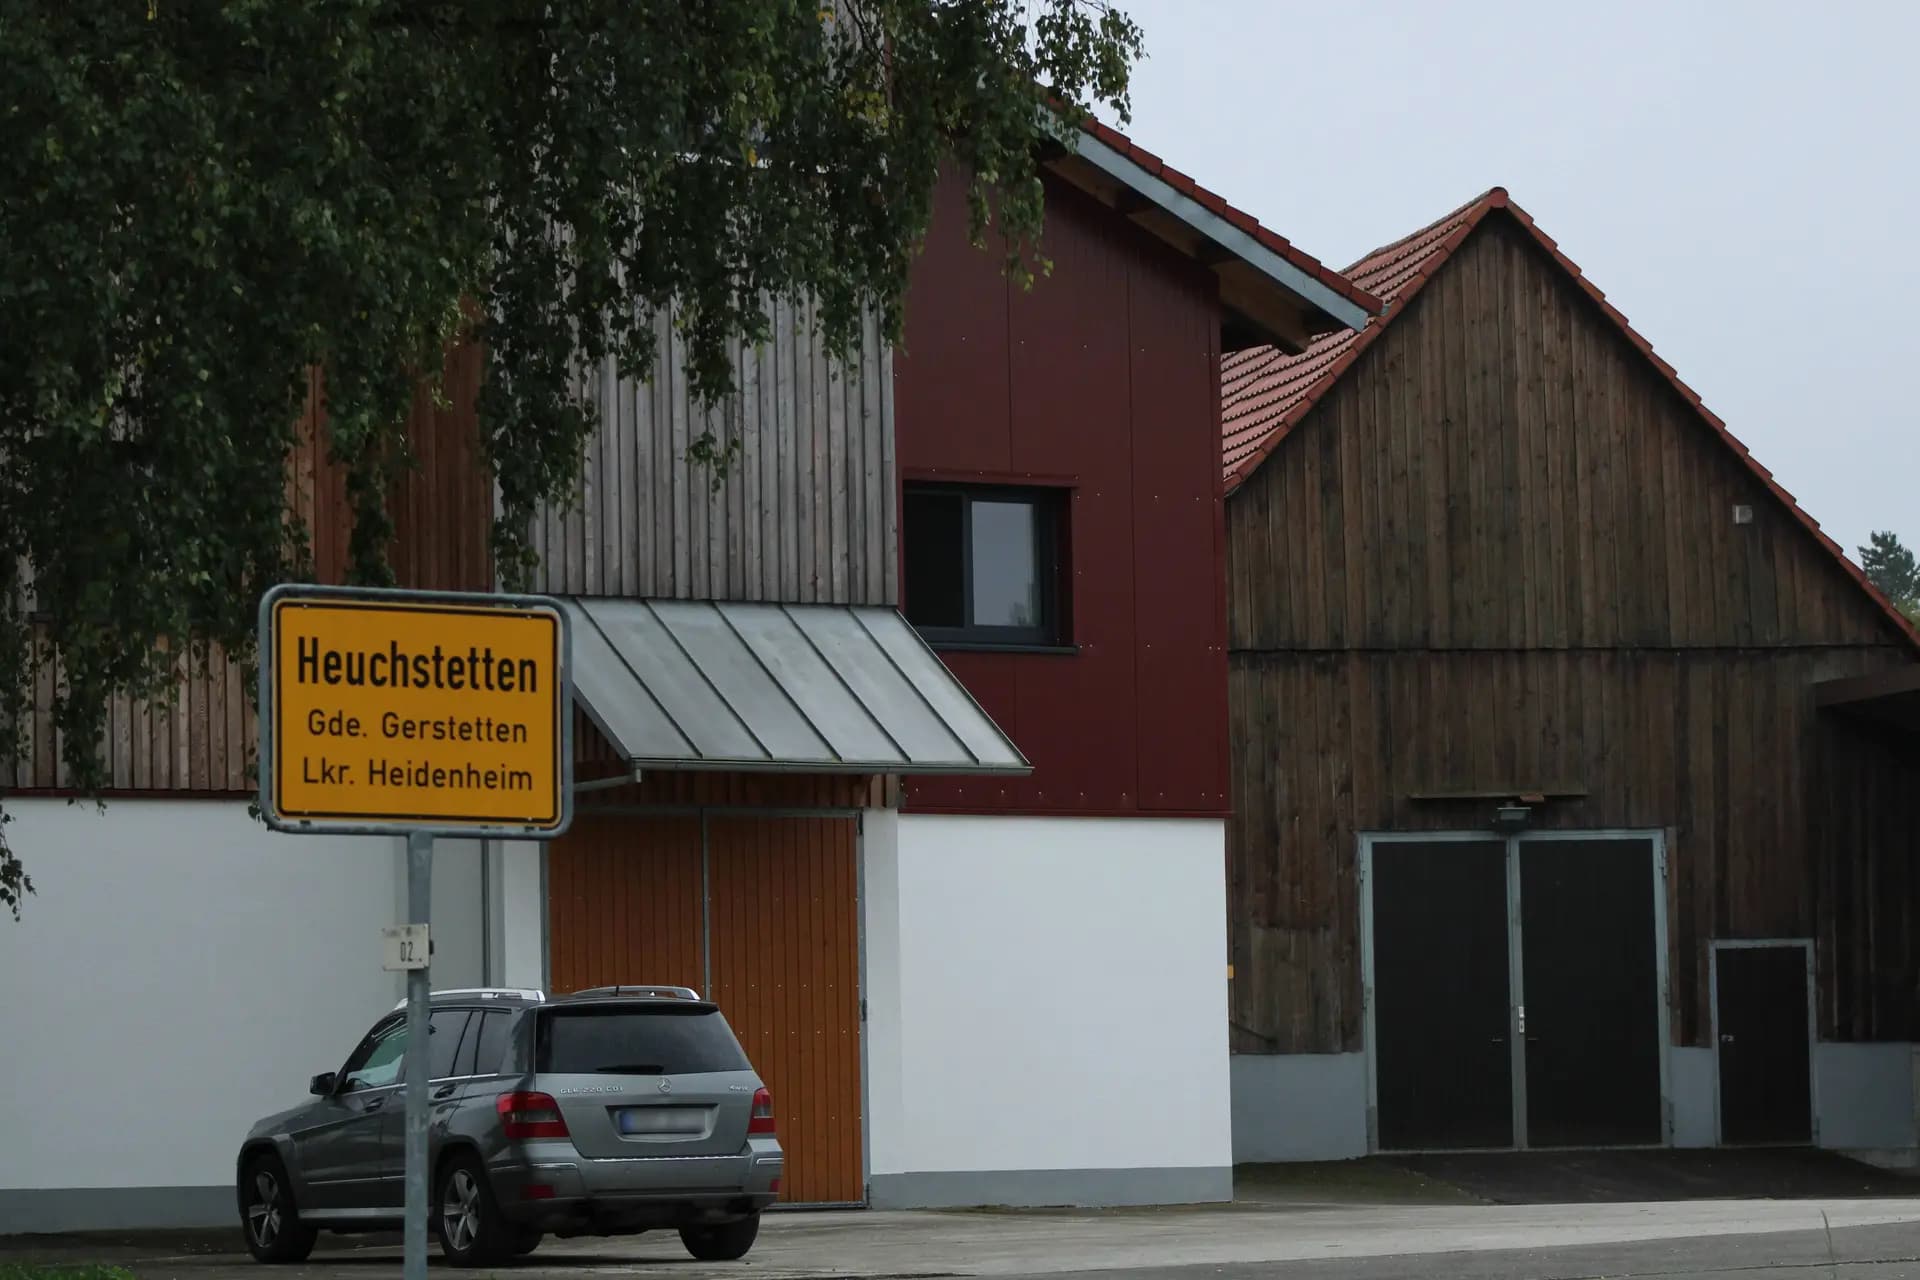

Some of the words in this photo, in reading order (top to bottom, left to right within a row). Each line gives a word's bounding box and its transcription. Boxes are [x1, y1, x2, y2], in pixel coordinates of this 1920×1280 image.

[298, 636, 537, 693] Heuchstetten
[308, 709, 367, 738] Gde.
[382, 712, 527, 743] Gerstetten
[303, 757, 354, 785] Lkr.
[369, 759, 533, 791] Heidenheim
